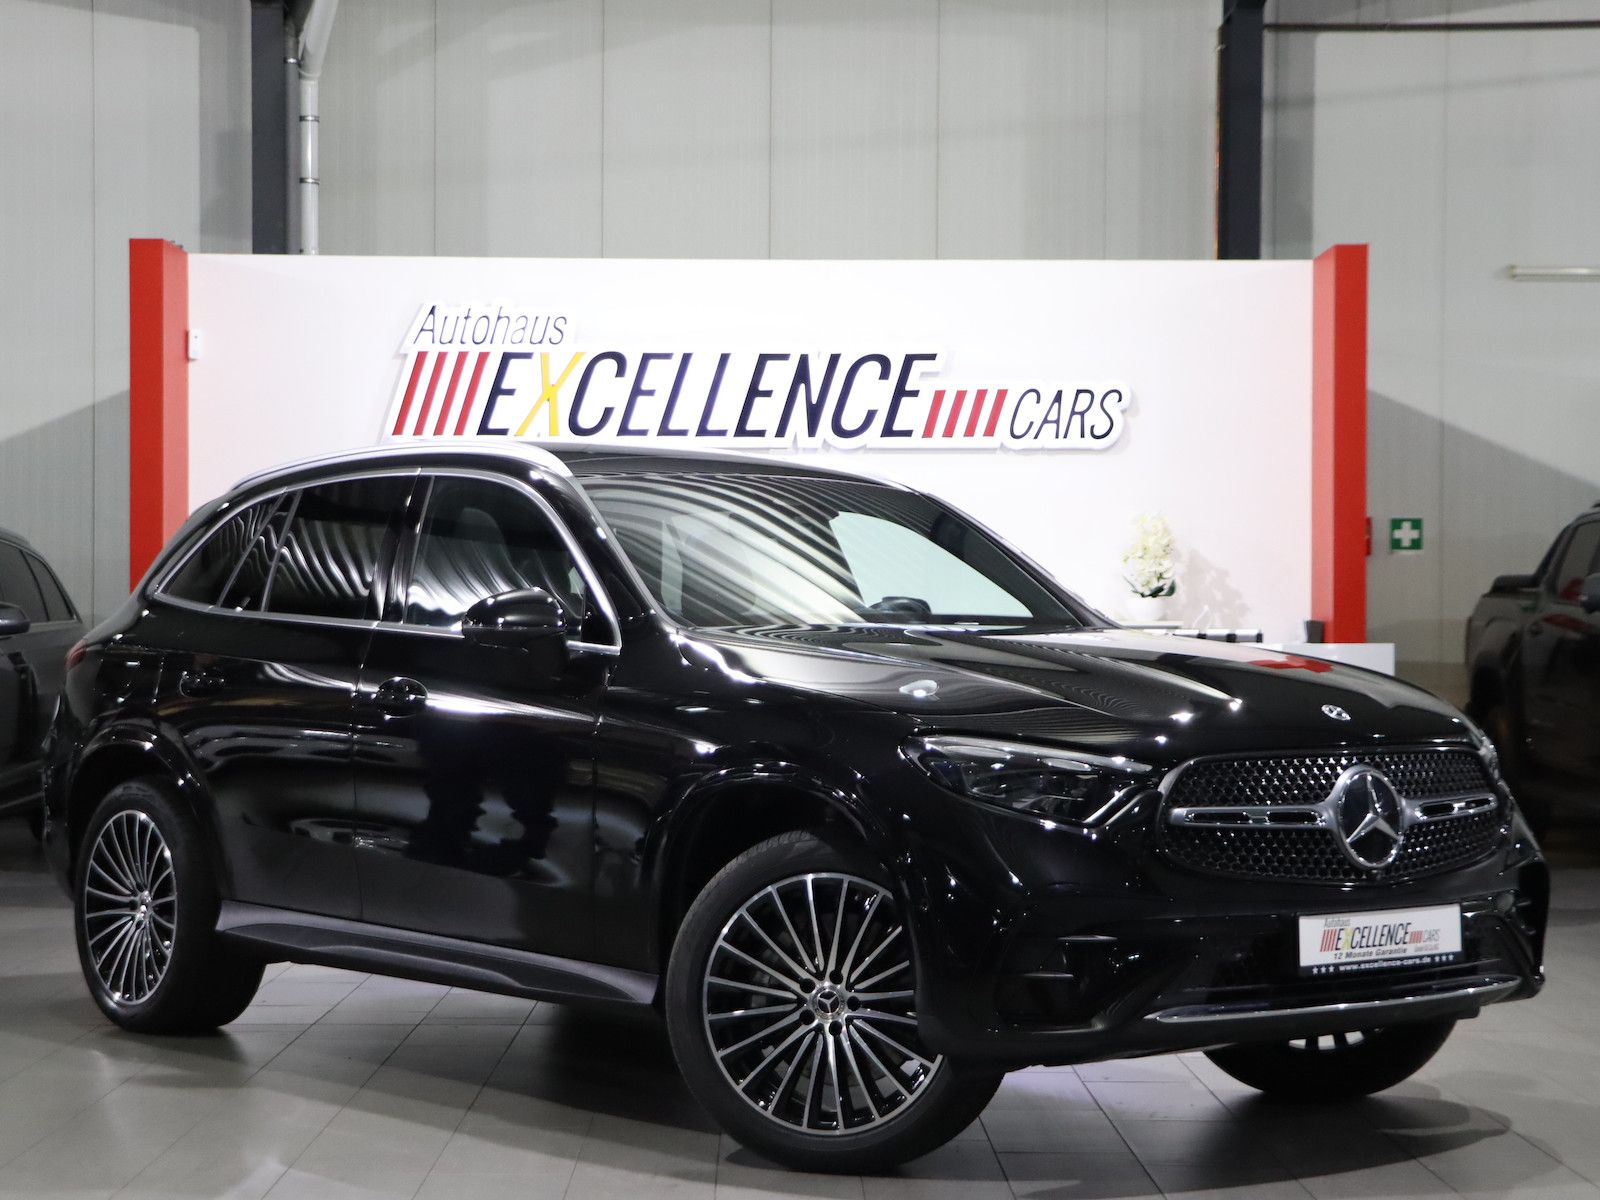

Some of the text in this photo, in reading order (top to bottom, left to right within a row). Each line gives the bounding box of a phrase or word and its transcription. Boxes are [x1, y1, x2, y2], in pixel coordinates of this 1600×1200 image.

[413, 304, 567, 345] Autohaus
[476, 350, 1123, 440] EXCELLENCE CARS
[1335, 922, 1412, 951] EXCELLENCE
